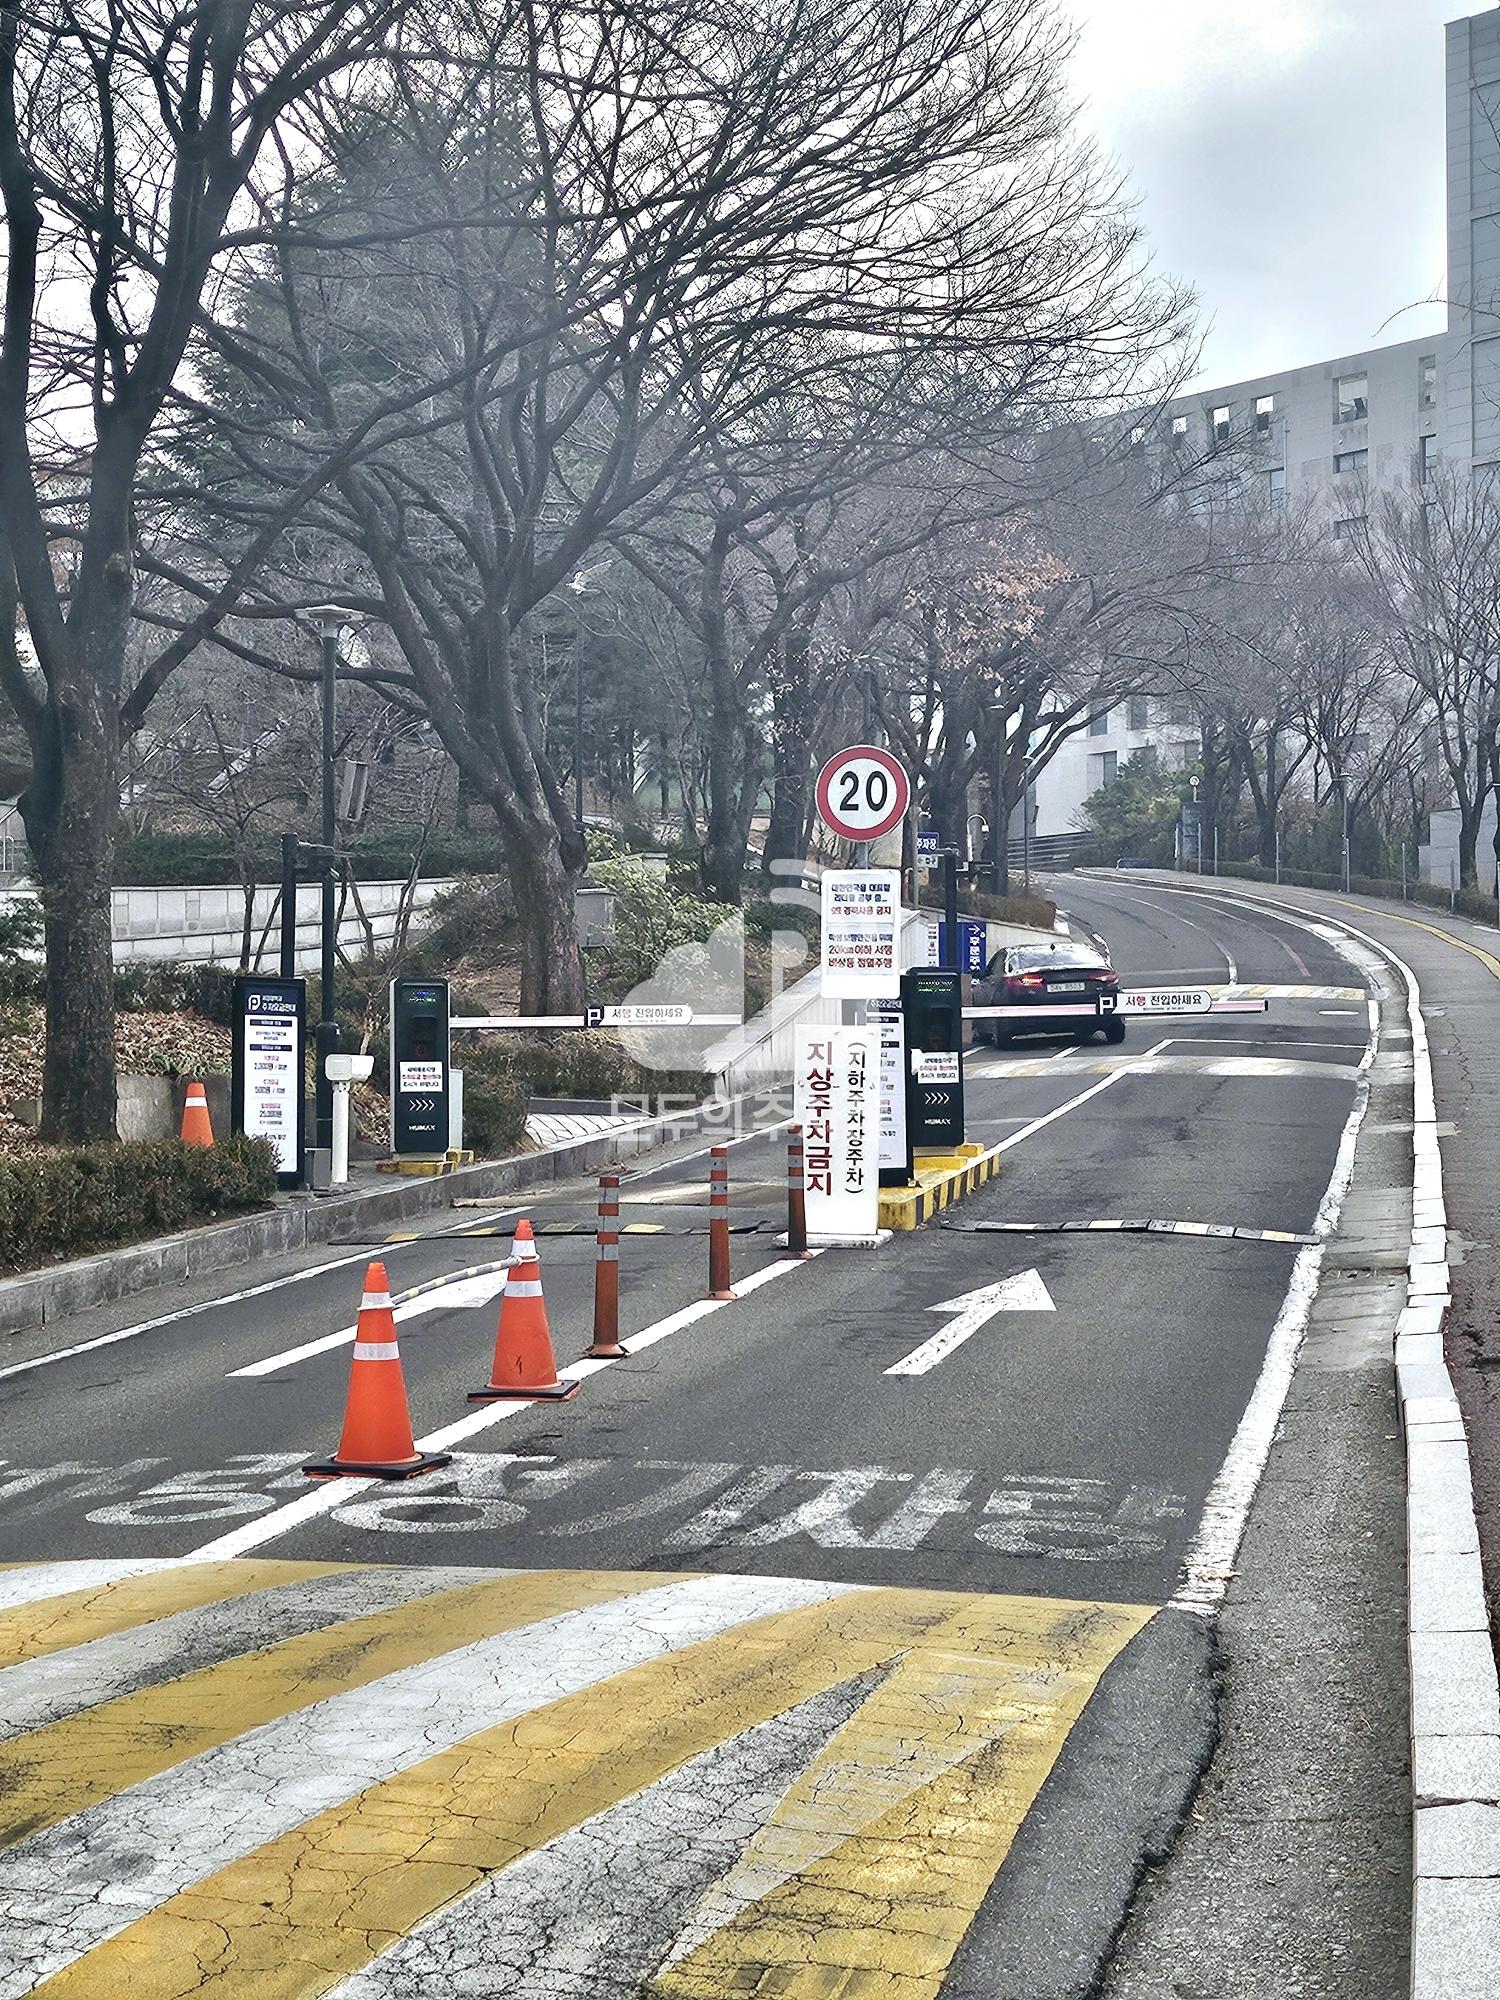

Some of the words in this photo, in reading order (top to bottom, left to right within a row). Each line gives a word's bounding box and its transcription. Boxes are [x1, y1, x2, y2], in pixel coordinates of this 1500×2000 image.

[839, 771, 888, 812] 20
[831, 884, 866, 892] 대한민국을
[877, 906, 891, 915] 금지
[875, 945, 892, 955] 서행
[828, 957, 854, 968] 비상등
[1125, 995, 1146, 1006] 서행
[1150, 994, 1202, 1006] 진입하세요
[612, 1008, 631, 1018] 서행
[635, 1007, 683, 1018] 진입하세요
[805, 1041, 833, 1196] 지상주차금지
[845, 1042, 867, 1194] (지하주차장주차)
